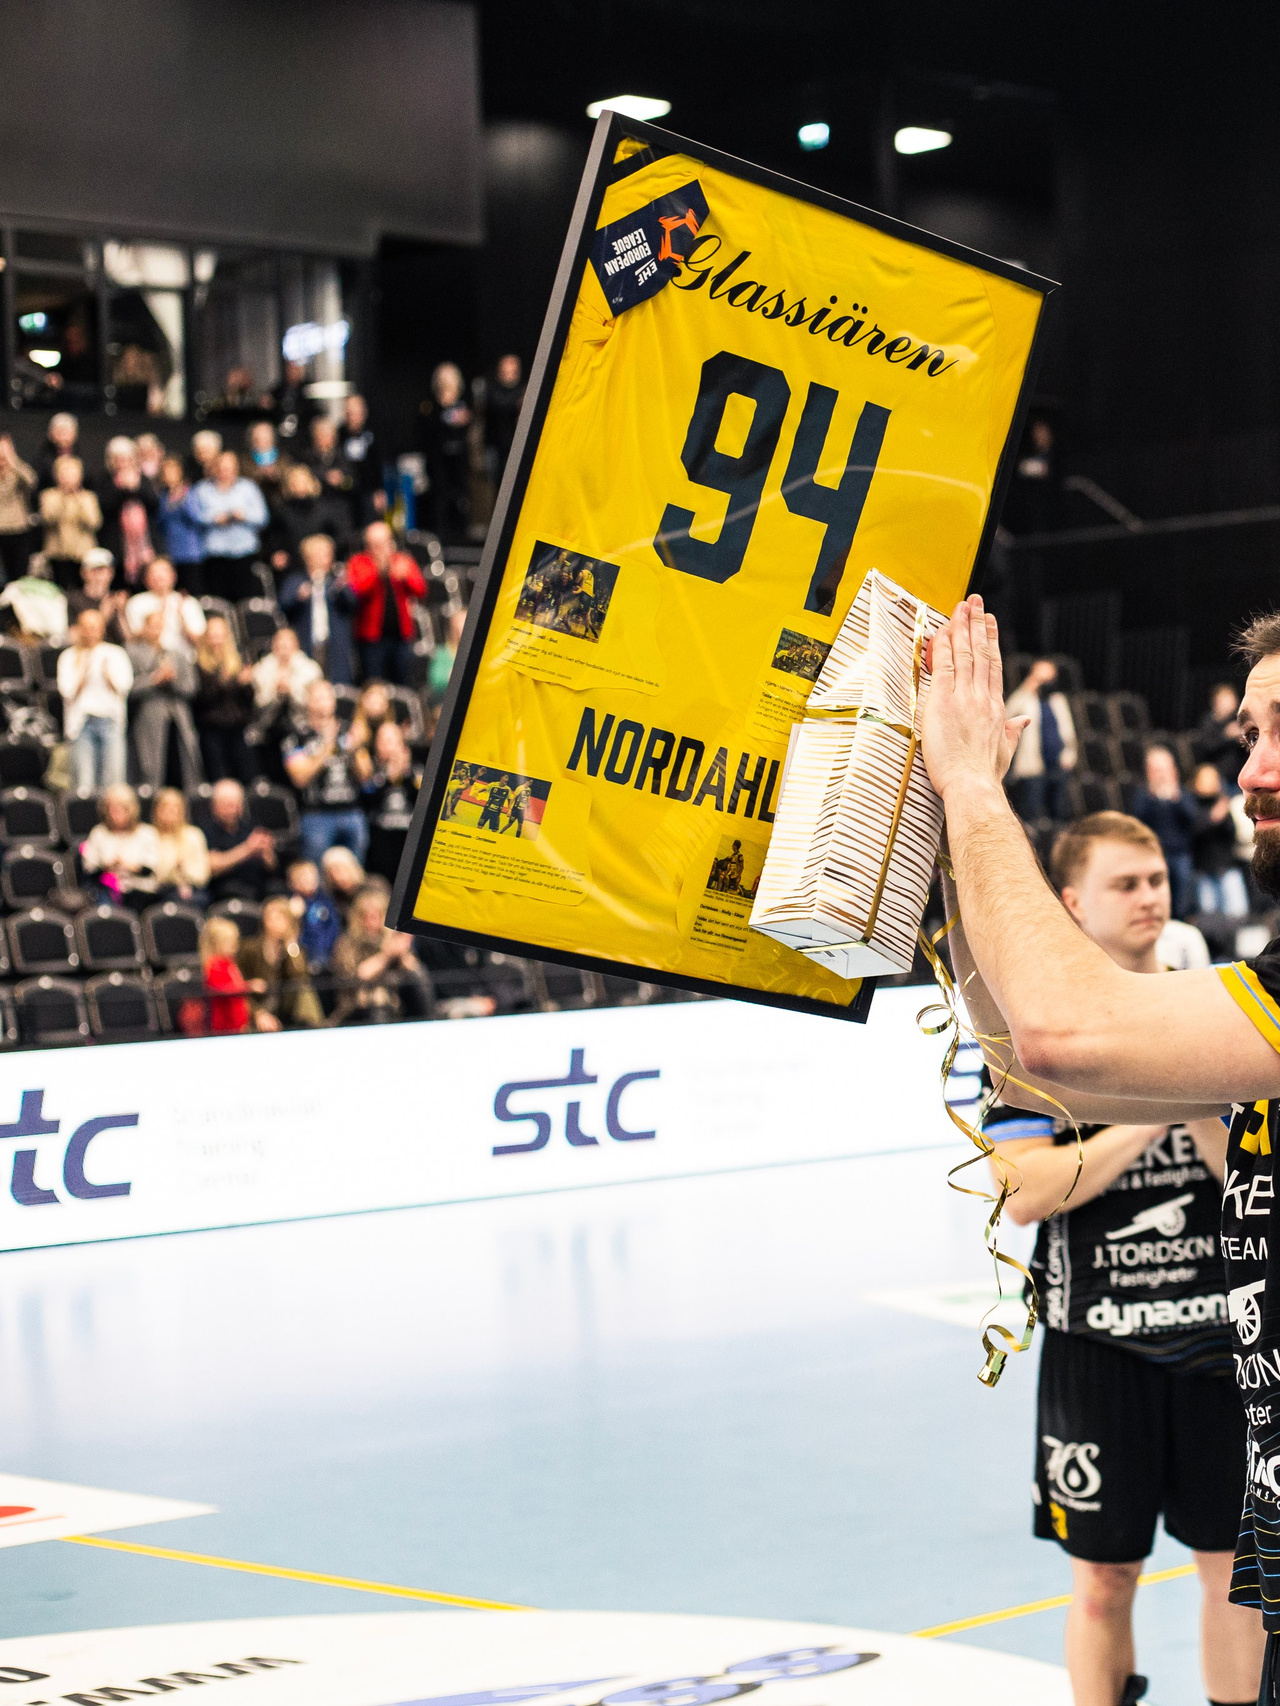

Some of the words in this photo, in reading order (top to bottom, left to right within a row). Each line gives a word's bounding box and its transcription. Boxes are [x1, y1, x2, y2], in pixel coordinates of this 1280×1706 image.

[604, 242, 652, 276] EUROPEAN
[612, 228, 646, 255] LEAGUE
[638, 261, 658, 286] EHF
[670, 234, 960, 378] Glassiären
[652, 350, 892, 618] 94
[566, 706, 781, 823] NORDAHL
[491, 1048, 660, 1158] stc
[0, 1089, 139, 1206] tc
[1222, 1168, 1275, 1220] KE
[1087, 1293, 1228, 1336] dynacon
